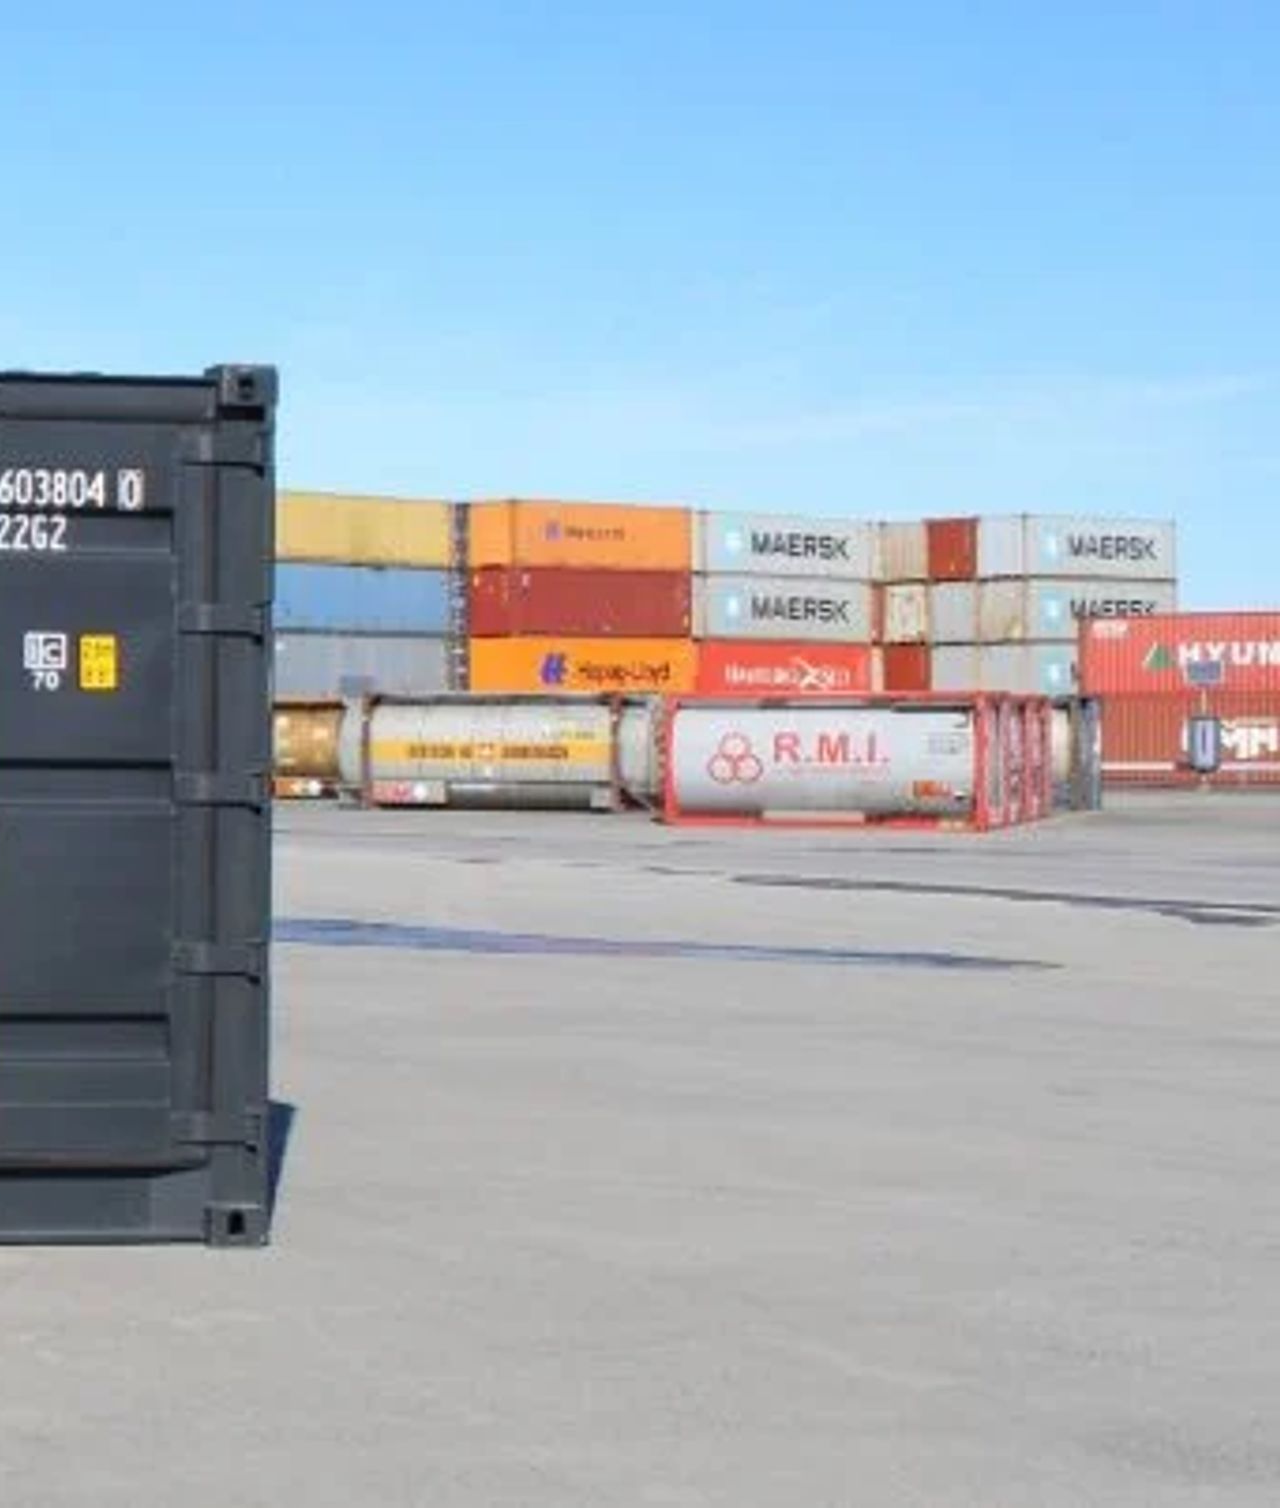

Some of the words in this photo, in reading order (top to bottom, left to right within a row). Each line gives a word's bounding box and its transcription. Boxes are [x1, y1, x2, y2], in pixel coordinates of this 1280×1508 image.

[121, 469, 141, 509] 0
[751, 531, 851, 561] MAERSK
[1070, 534, 1158, 561] MAERSK
[751, 596, 851, 624] MAERSK
[32, 670, 60, 691] 70
[773, 730, 890, 764] R.M.I.
